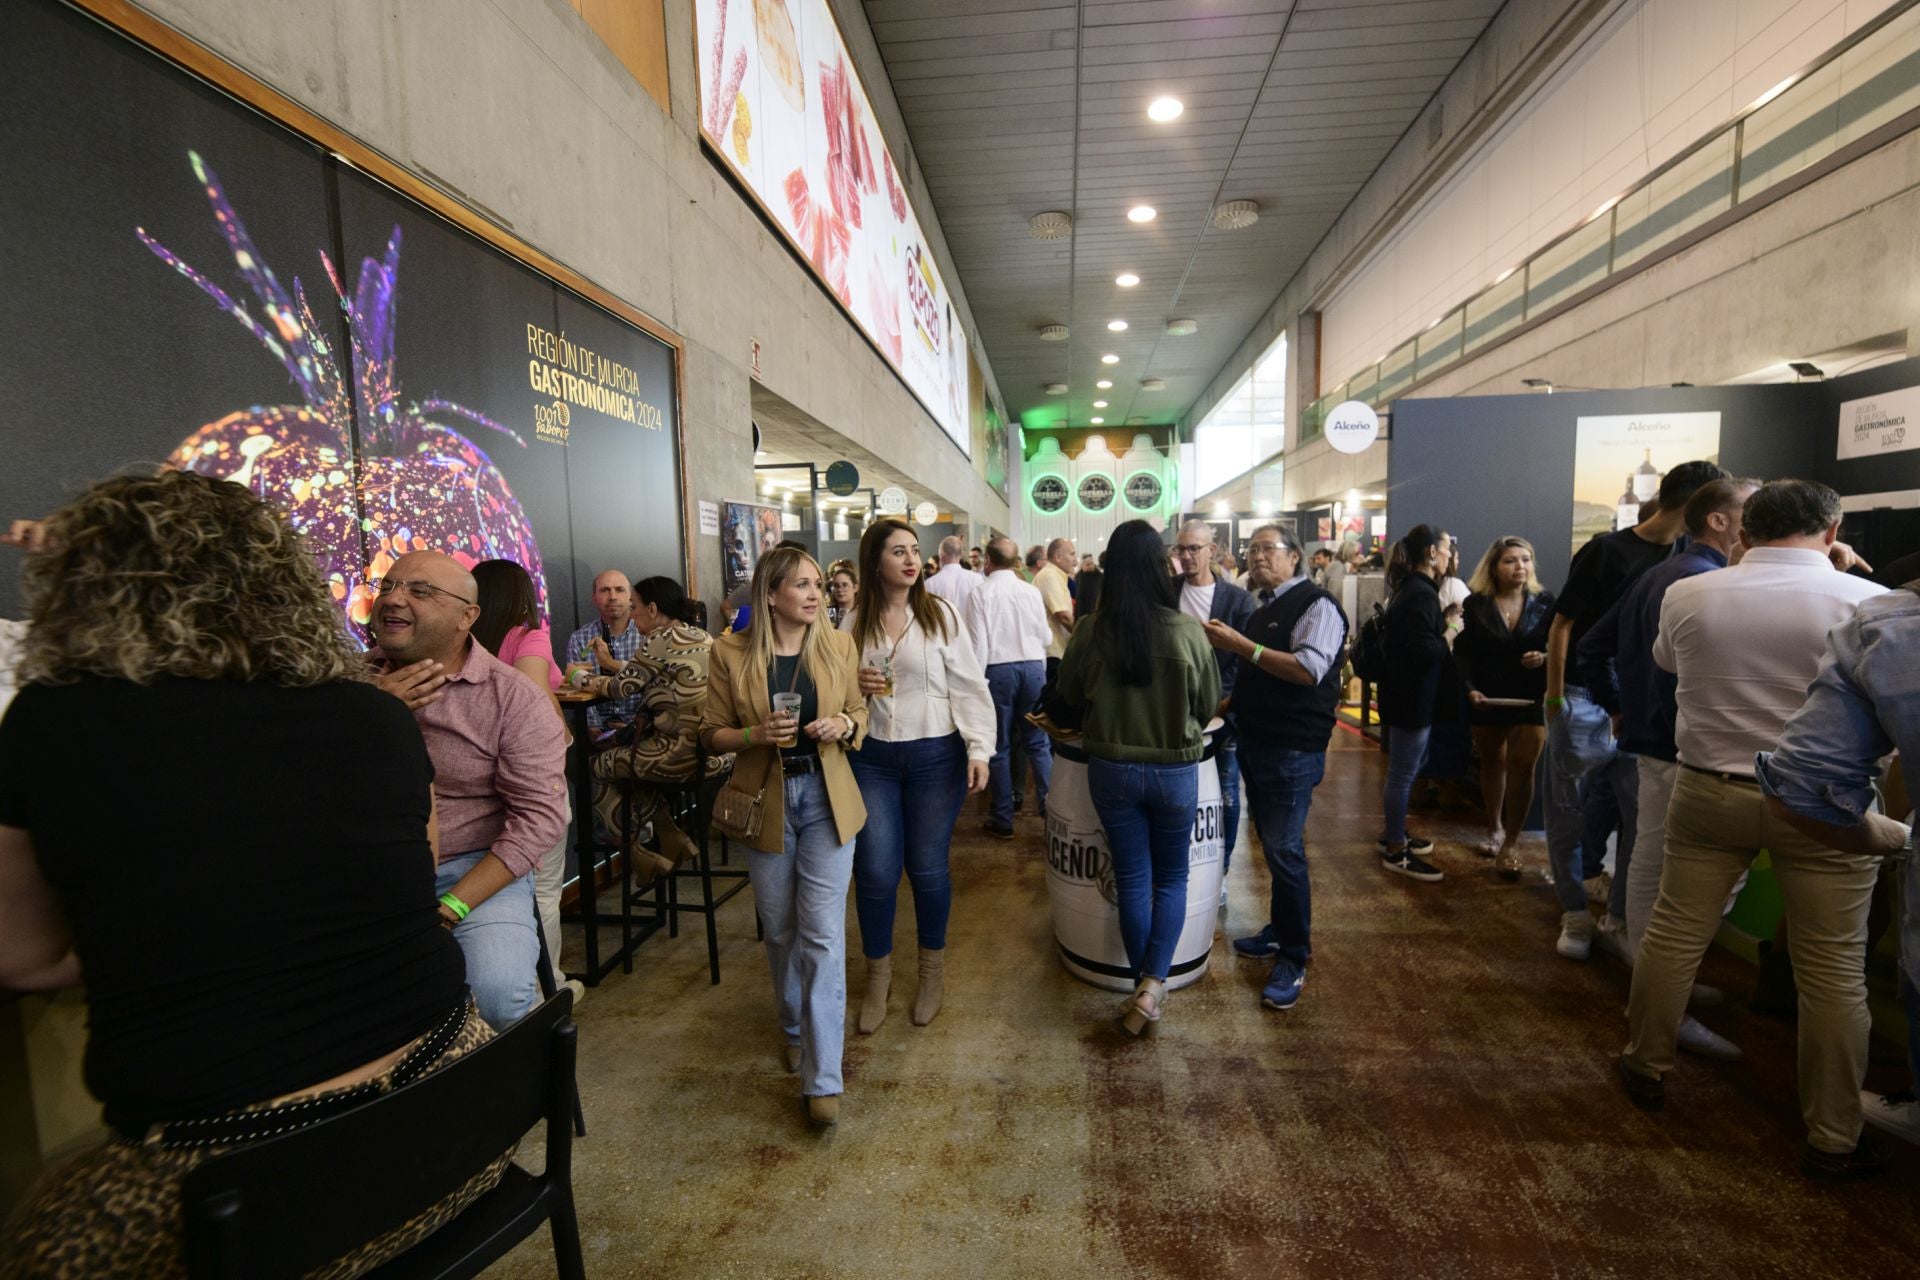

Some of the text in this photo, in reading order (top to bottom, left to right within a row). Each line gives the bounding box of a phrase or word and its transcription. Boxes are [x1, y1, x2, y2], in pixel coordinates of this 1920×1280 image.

[527, 323, 640, 397] REGIÓN DE MURCIA
[529, 360, 663, 432] GASTRONÓMICA 2024
